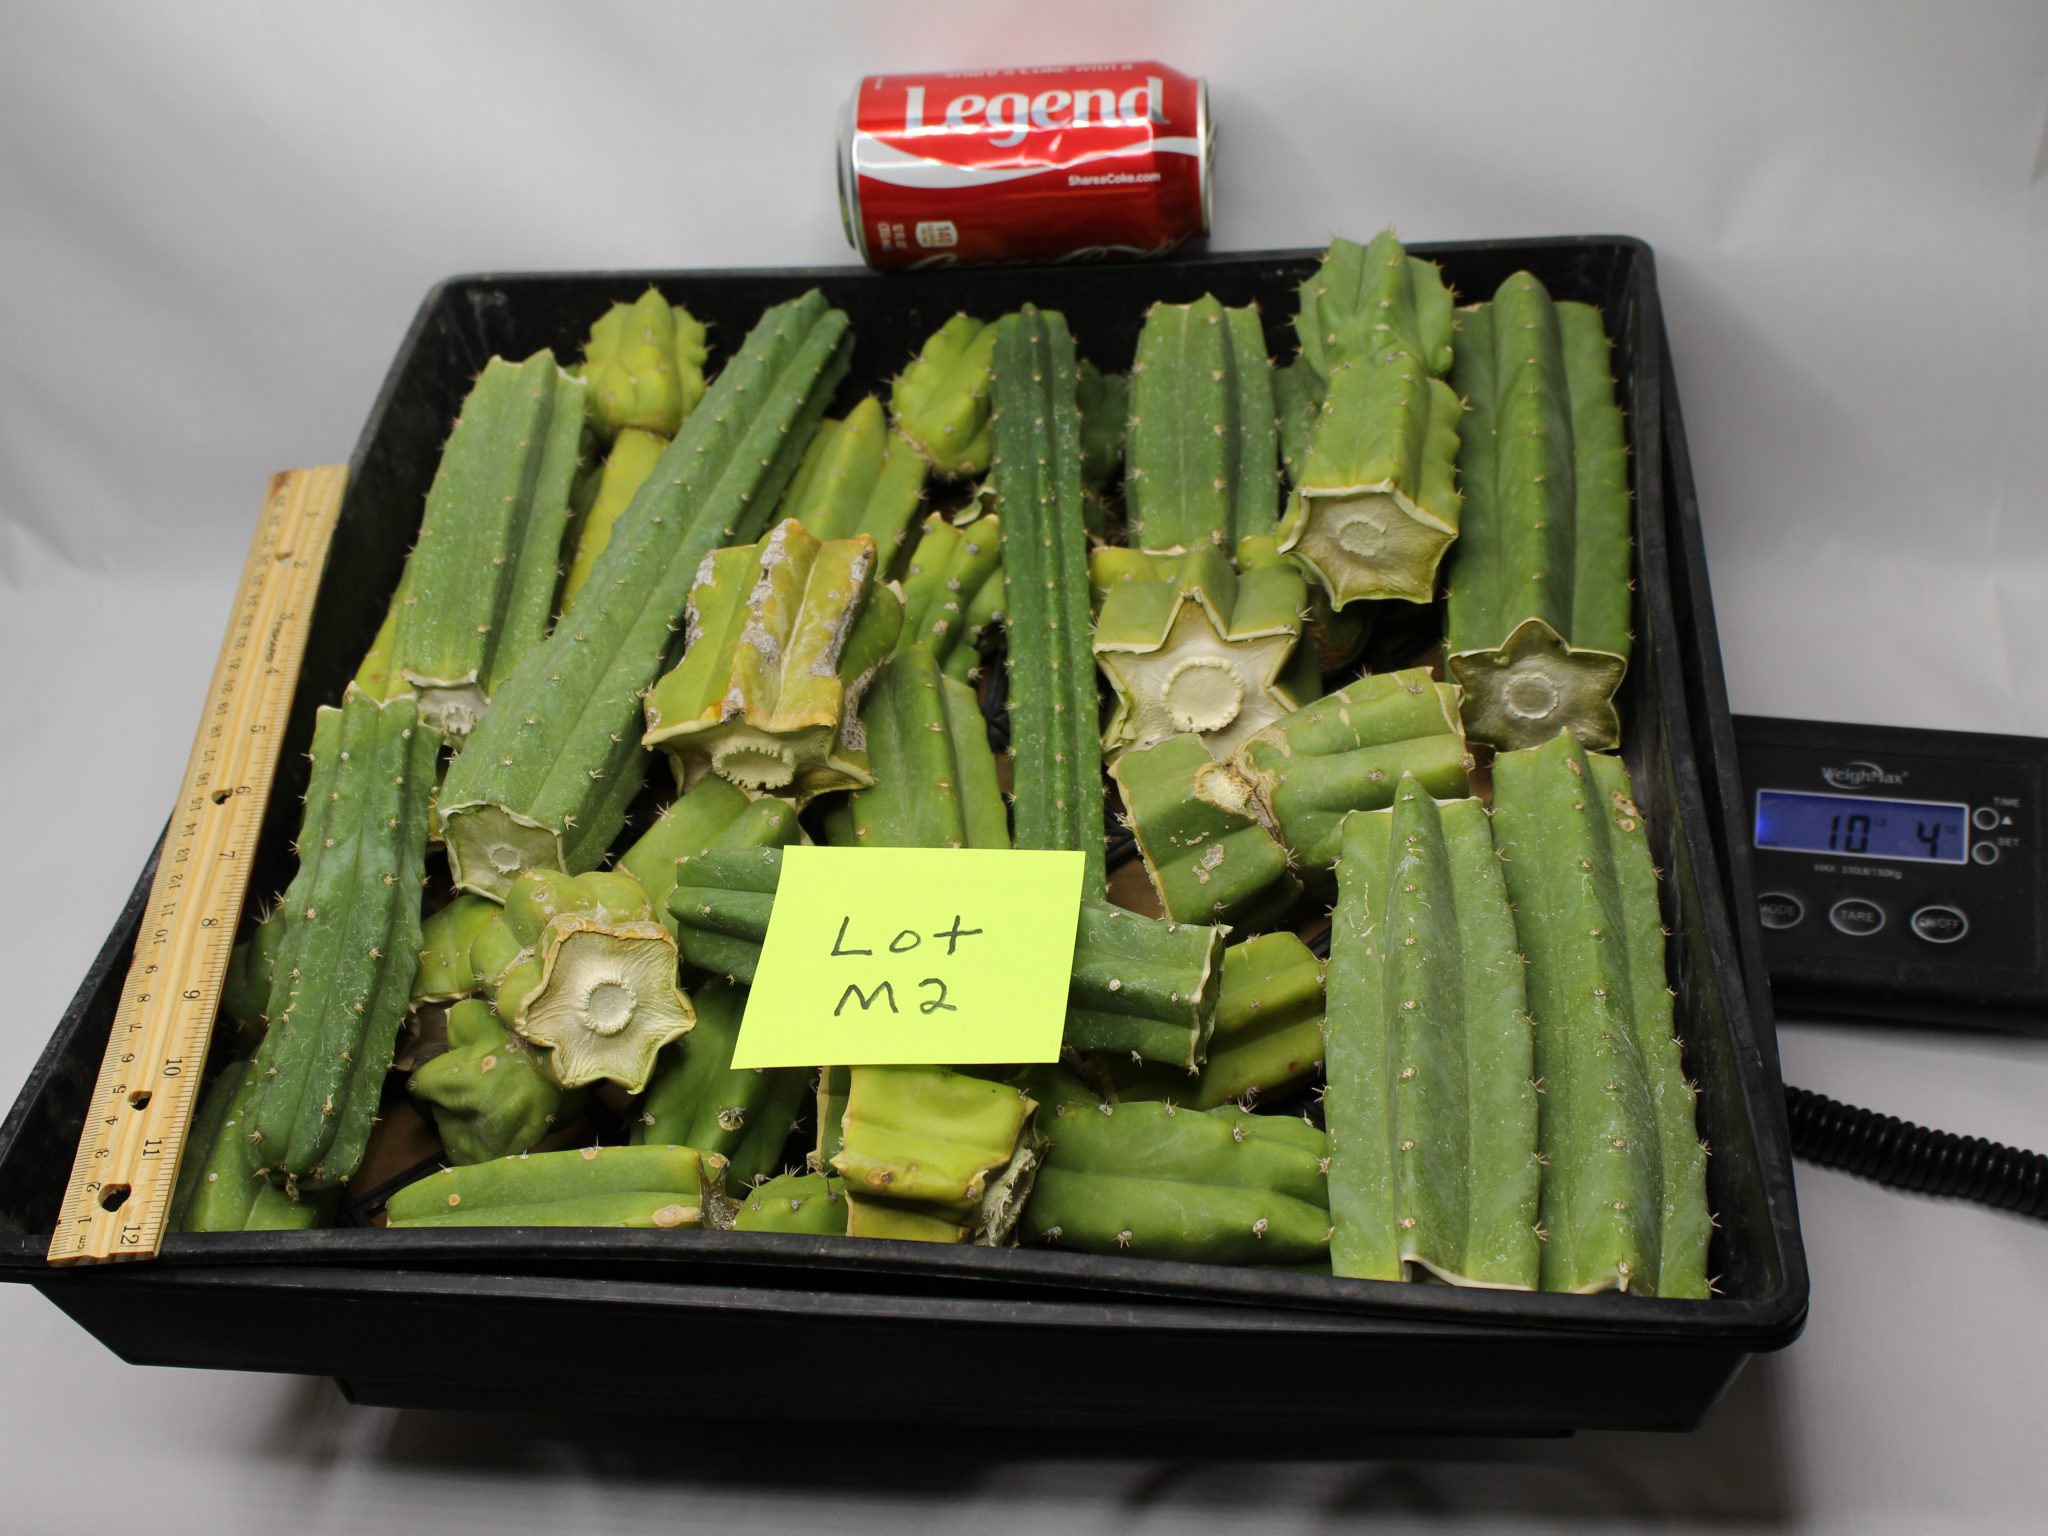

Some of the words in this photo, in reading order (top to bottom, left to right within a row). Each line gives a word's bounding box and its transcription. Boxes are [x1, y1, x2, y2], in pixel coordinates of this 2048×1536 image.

[904, 76, 1171, 148] Legend
[1067, 171, 1161, 187] ShareaCoke.com
[293, 560, 308, 568] 2
[280, 612, 295, 620] 3
[234, 635, 248, 650] 22
[228, 657, 242, 671] 21
[265, 667, 280, 675] 4
[216, 701, 230, 717] 19
[209, 725, 222, 740] 18
[250, 725, 266, 733] 5
[203, 750, 216, 763] 17
[196, 772, 210, 787] 16
[235, 785, 251, 794] 6
[189, 797, 204, 812] 15
[1993, 797, 2021, 807] TIME
[183, 822, 197, 838] 14
[1829, 815, 1871, 853] 10
[1916, 821, 1941, 858] 4
[1997, 838, 2020, 847] SET
[176, 848, 190, 863] 13
[219, 850, 235, 858] 7
[169, 873, 184, 890] 12
[162, 901, 176, 917] 11
[201, 918, 219, 926] 8
[1840, 909, 1874, 923] TARE
[1918, 917, 1961, 929] ON/OFF
[154, 929, 169, 945] 10
[830, 915, 983, 957] Lot
[145, 965, 158, 974] 9
[137, 994, 151, 1003] 8
[183, 990, 201, 1000] 9
[129, 1023, 143, 1032] 7
[121, 1053, 135, 1063] 6
[163, 1058, 182, 1076] 10
[113, 1085, 127, 1094] 5
[105, 1116, 119, 1126] 4
[95, 1148, 110, 1159] 3
[143, 1140, 162, 1157] 11
[86, 1182, 101, 1192] 2
[78, 1216, 92, 1224] 1
[120, 1225, 141, 1245] 12
[77, 1234, 86, 1250] cm
